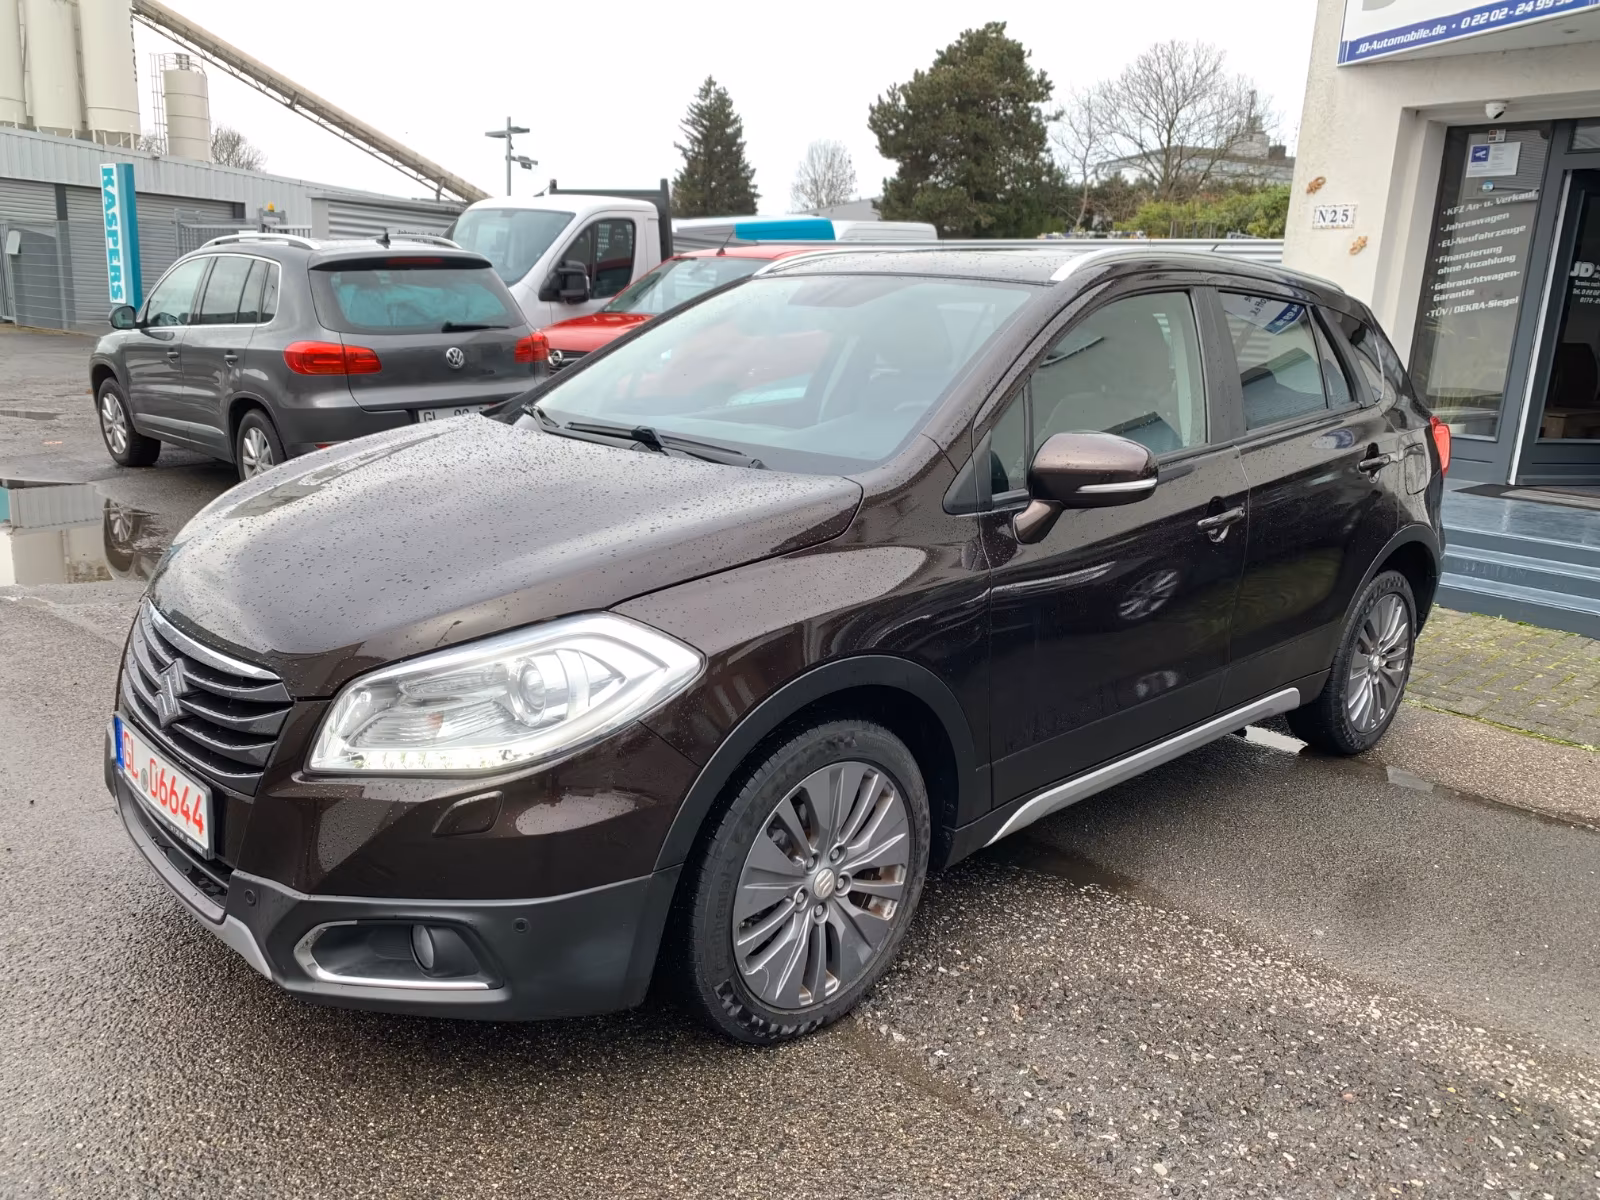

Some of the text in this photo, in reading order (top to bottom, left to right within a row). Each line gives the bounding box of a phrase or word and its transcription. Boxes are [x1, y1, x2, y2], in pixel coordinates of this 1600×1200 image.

[1355, 25, 1447, 54] JD-Automobile.de
[1447, 205, 1465, 216] KFZ
[1496, 190, 1537, 205] Verkauf
[1444, 213, 1510, 232] Jahreswagen
[101, 167, 123, 300] KASPERS
[1441, 225, 1527, 248] EU-Neufahrzeuge
[1437, 254, 1517, 275] ohne Anzahlung
[1439, 246, 1503, 264] Finanzierung
[1569, 260, 1595, 277] JD
[1434, 270, 1520, 291] Gebrauchtwagen-
[1433, 289, 1475, 302] Garantie
[1430, 307, 1450, 317] TÜV
[1453, 296, 1519, 314] DEKRA-Siegel
[124, 731, 204, 836] GL 06644
